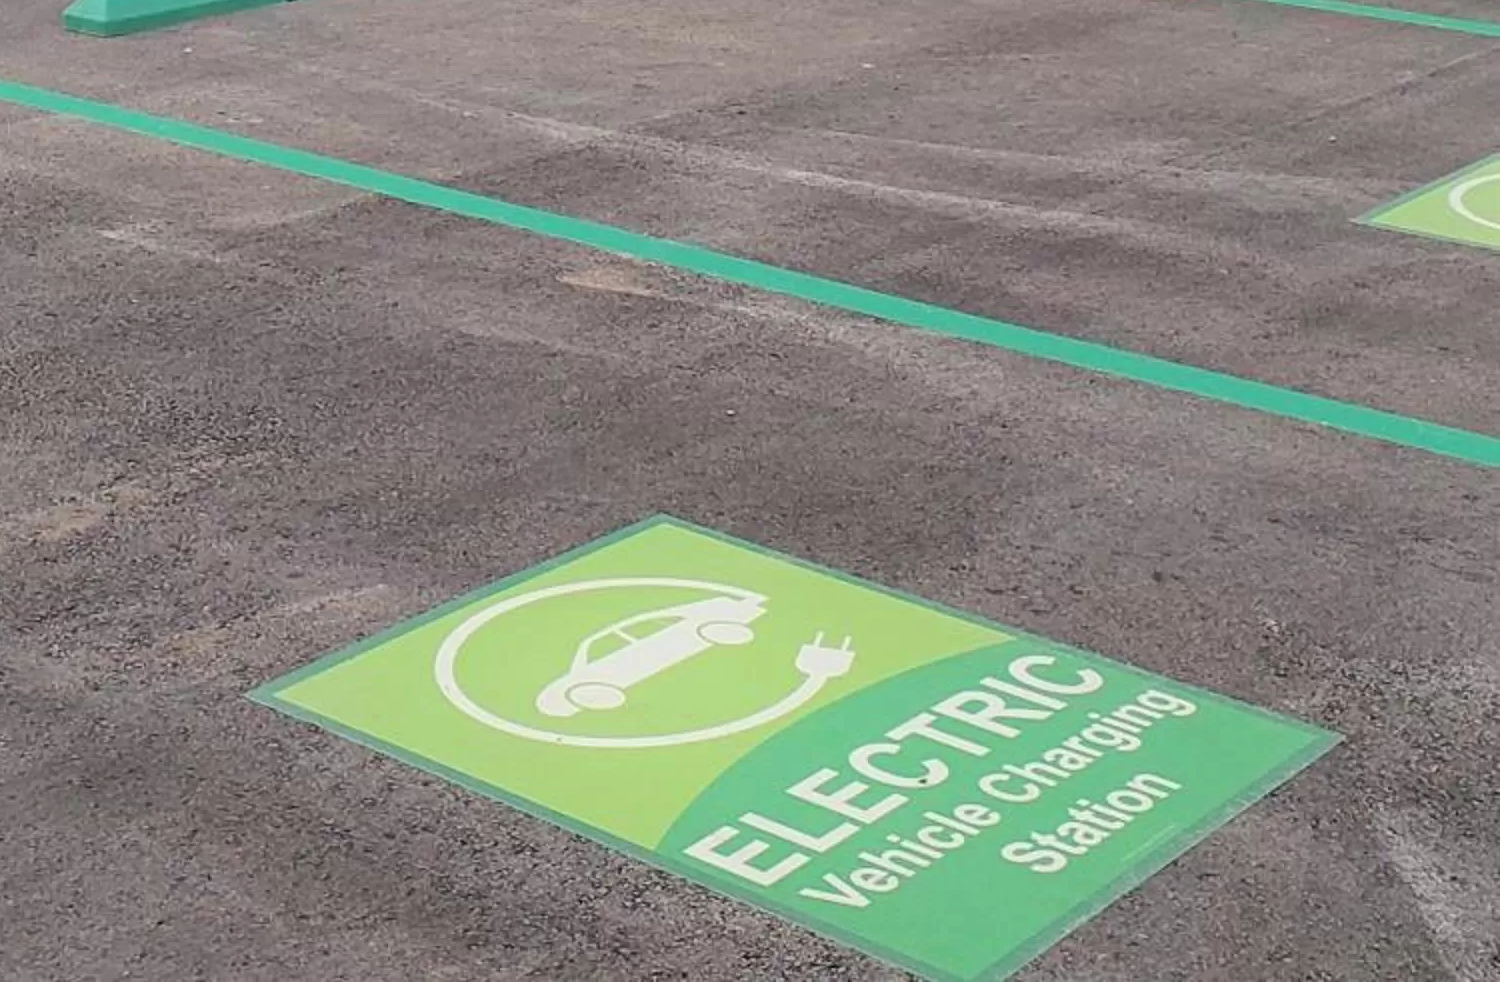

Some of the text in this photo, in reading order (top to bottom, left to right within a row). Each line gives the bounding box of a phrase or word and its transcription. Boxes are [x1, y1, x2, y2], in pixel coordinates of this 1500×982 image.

[683, 654, 1104, 887] ELECTRIC
[799, 689, 1197, 908] Vehicle Charging
[1001, 770, 1182, 874] Station
